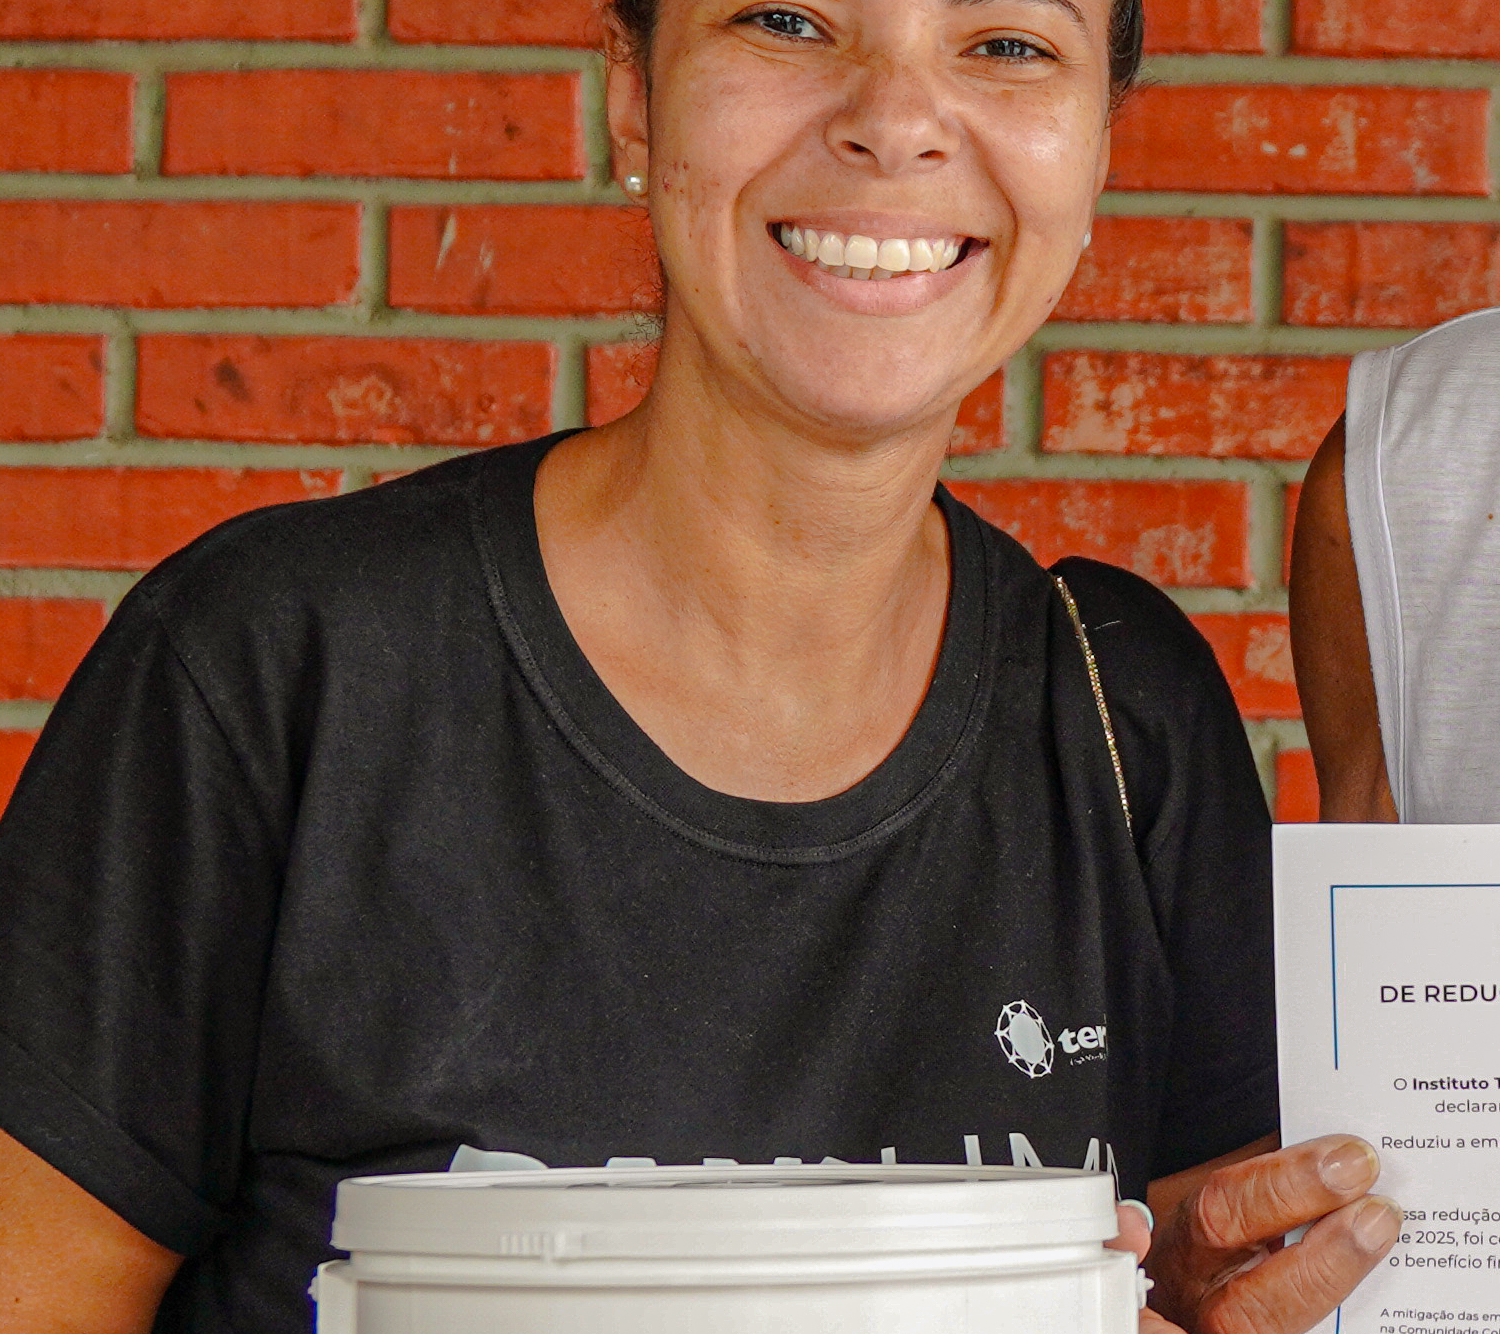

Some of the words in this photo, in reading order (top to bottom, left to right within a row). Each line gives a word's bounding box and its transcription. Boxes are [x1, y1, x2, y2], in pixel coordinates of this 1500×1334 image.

[1380, 984, 1416, 1004] DE
[1393, 1076, 1408, 1091] O
[1412, 1075, 1490, 1091] Instituto
[1415, 1229, 1459, 1248] 2025,
[1462, 1230, 1484, 1247] foi
